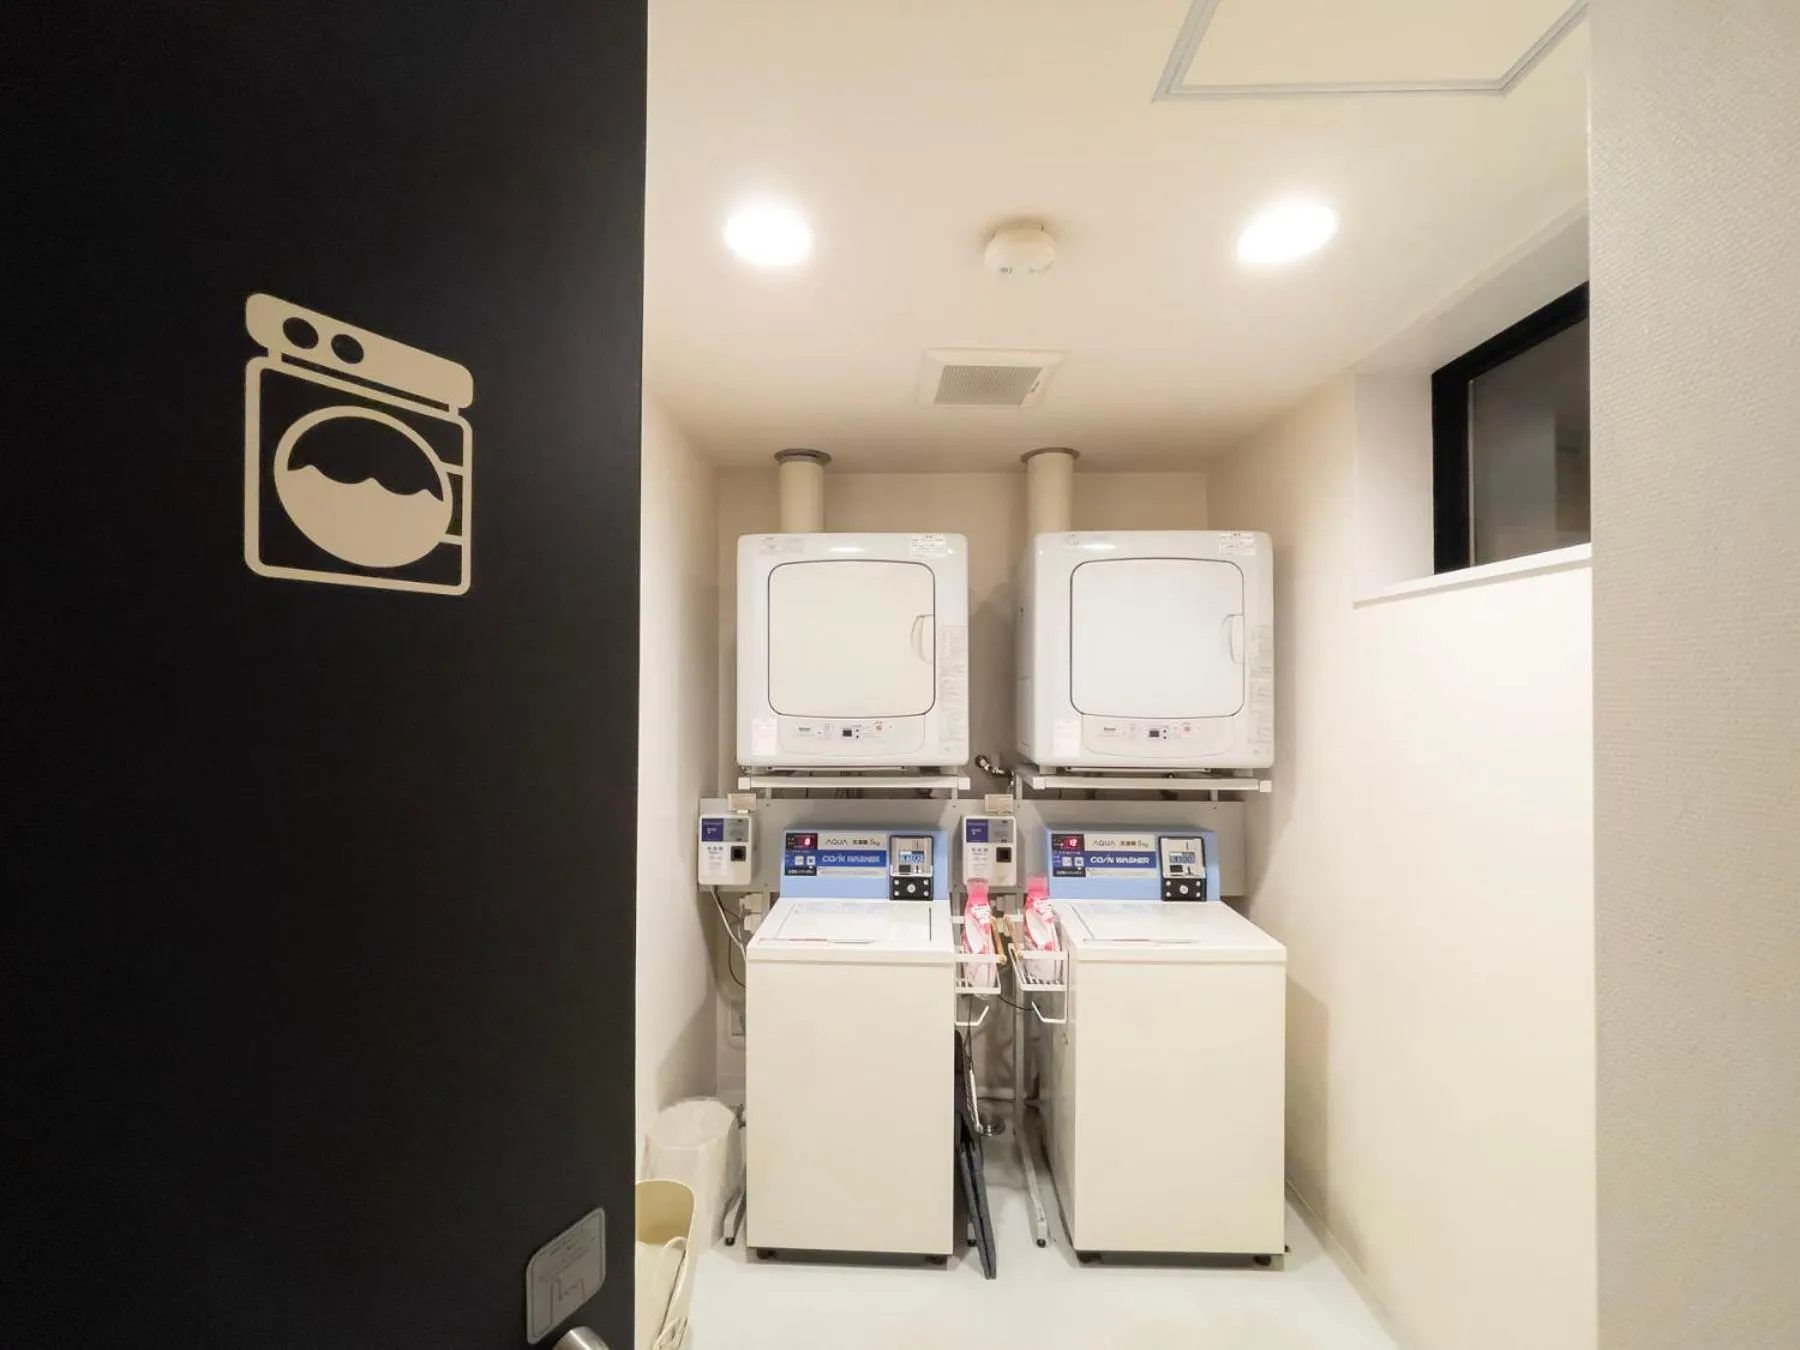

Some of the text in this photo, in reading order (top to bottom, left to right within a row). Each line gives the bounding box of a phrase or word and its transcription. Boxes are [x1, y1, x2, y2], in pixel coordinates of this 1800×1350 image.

[825, 838, 848, 846] AQUA
[1092, 839, 1116, 847] AQUA
[1115, 855, 1150, 864] WASHER
